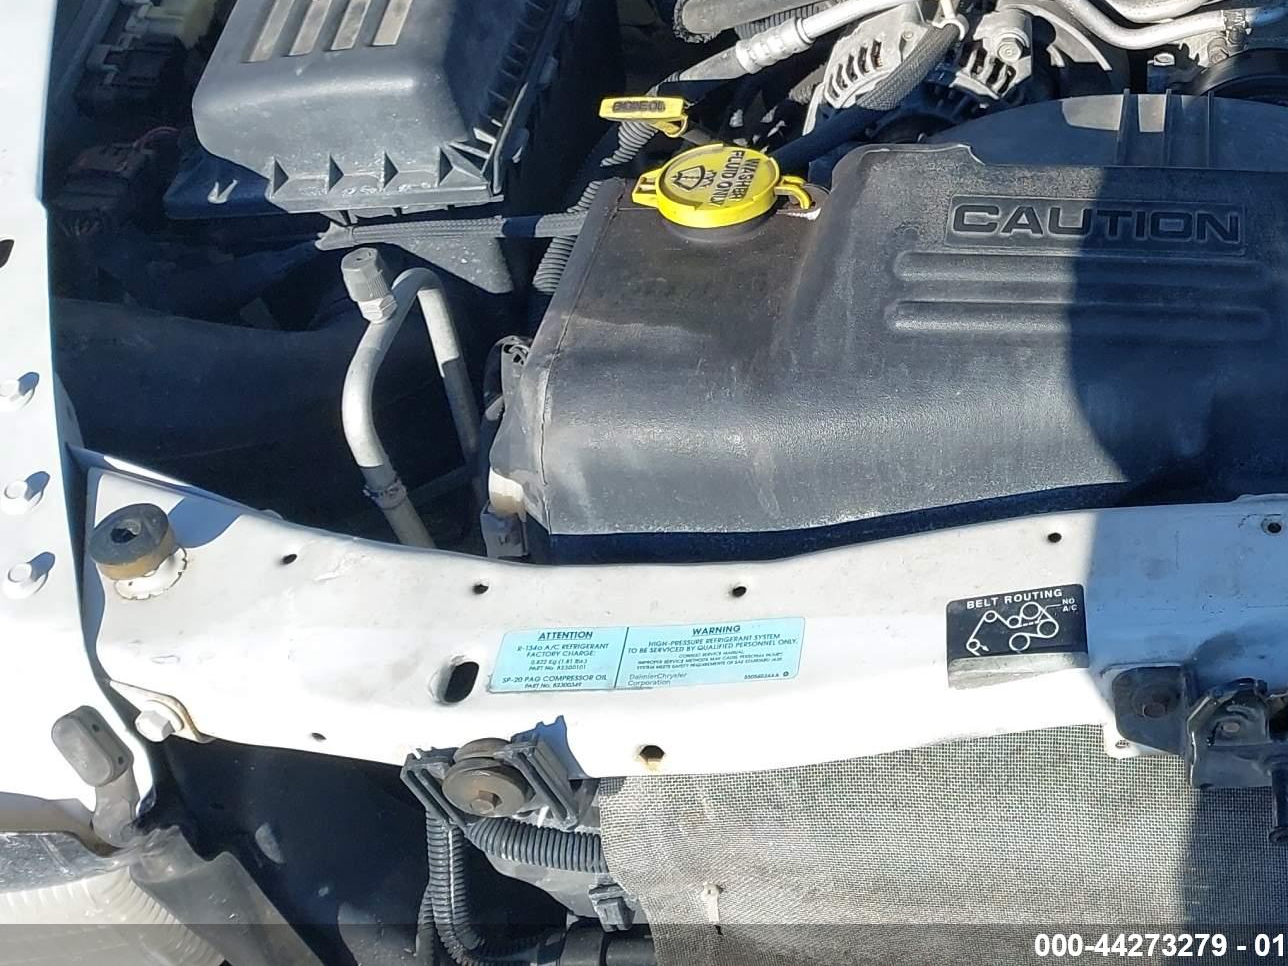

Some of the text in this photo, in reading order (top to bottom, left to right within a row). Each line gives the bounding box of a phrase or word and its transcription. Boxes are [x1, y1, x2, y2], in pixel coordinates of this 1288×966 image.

[708, 150, 746, 207] FLUID ONLY
[730, 157, 761, 202] WASHER
[951, 202, 1243, 245] CAUTION
[966, 588, 1063, 610] BELT ROUTING
[539, 631, 593, 640] ATTENTION
[692, 625, 741, 635] WARNING
[649, 638, 704, 647] HIGH-PRESSURE
[705, 635, 752, 644] REFRIGERANT
[697, 643, 734, 651] QUALIFIED
[735, 640, 776, 648] PERSONNEL
[628, 672, 688, 680] DaimlerChrysler
[628, 679, 671, 687] Corporation
